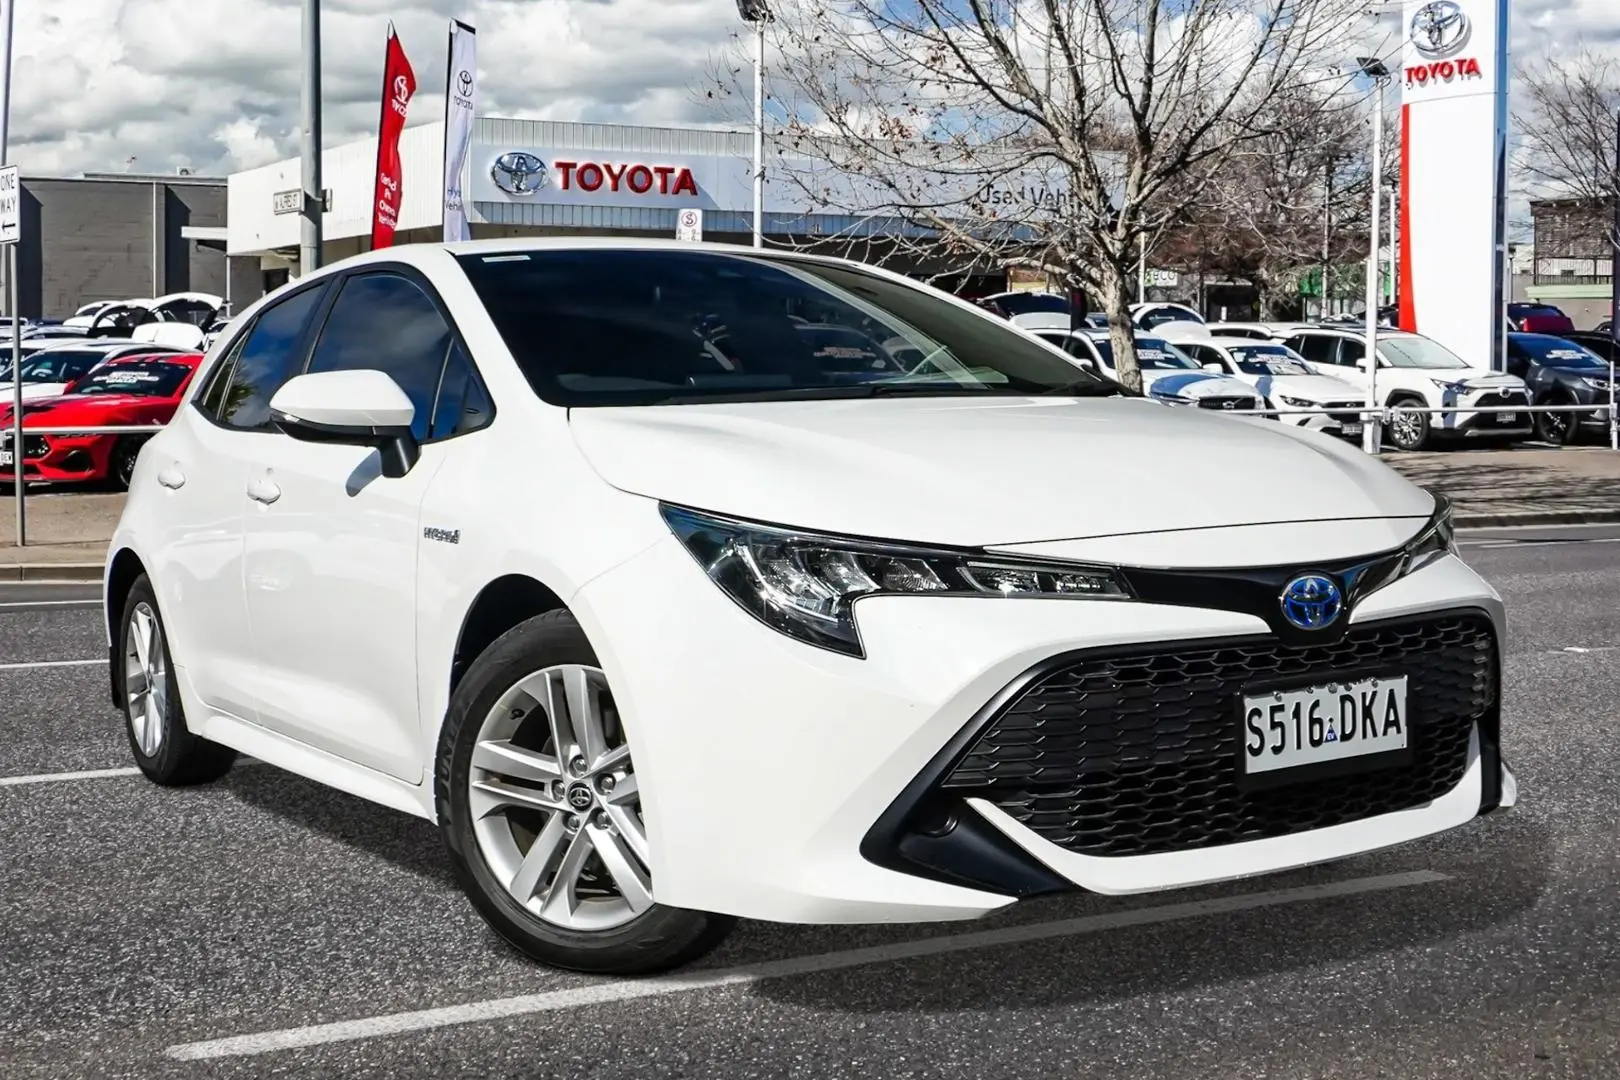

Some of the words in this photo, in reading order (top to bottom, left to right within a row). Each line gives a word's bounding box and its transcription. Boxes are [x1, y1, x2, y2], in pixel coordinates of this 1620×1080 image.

[1404, 58, 1481, 83] TOYOTA
[1, 173, 15, 192] ONE
[555, 161, 698, 196] TOYOTA
[1246, 699, 1325, 757] S516
[1338, 688, 1402, 743] DKA
